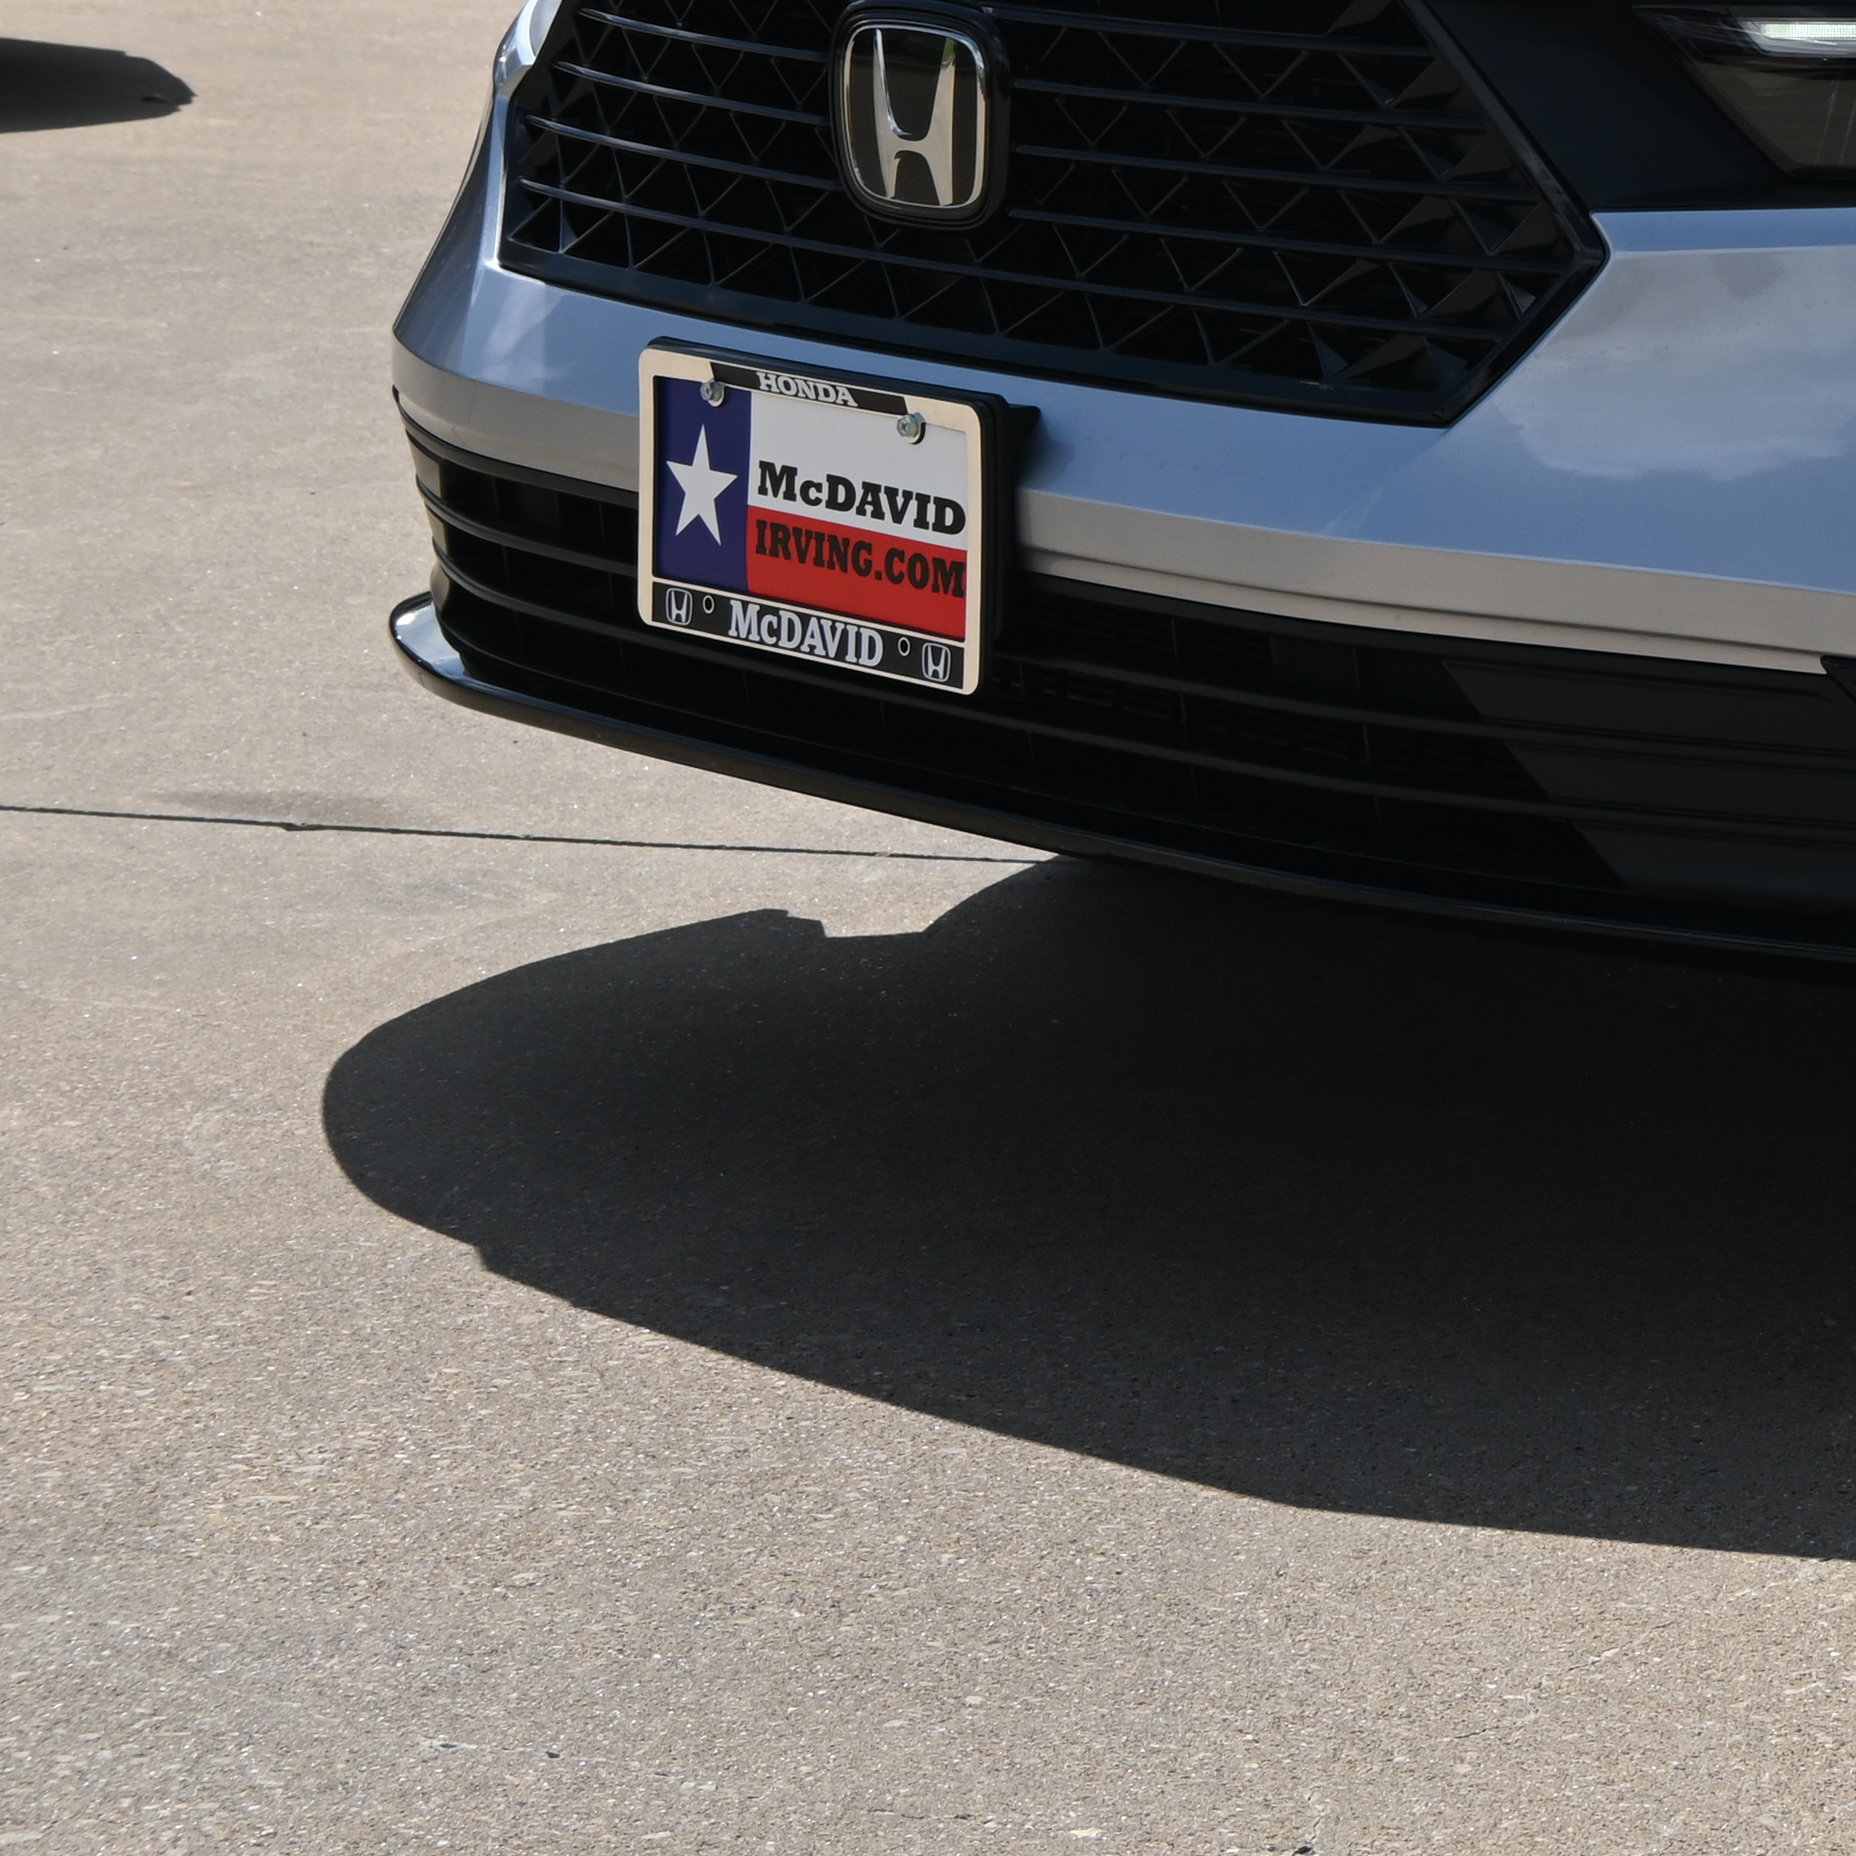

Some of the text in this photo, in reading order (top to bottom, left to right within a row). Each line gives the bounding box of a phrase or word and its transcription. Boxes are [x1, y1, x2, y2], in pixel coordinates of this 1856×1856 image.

[756, 371, 858, 408] HONDA
[757, 460, 966, 536] McDAVID
[755, 520, 966, 598] IRVING.COM
[728, 598, 884, 668] McDAVID
